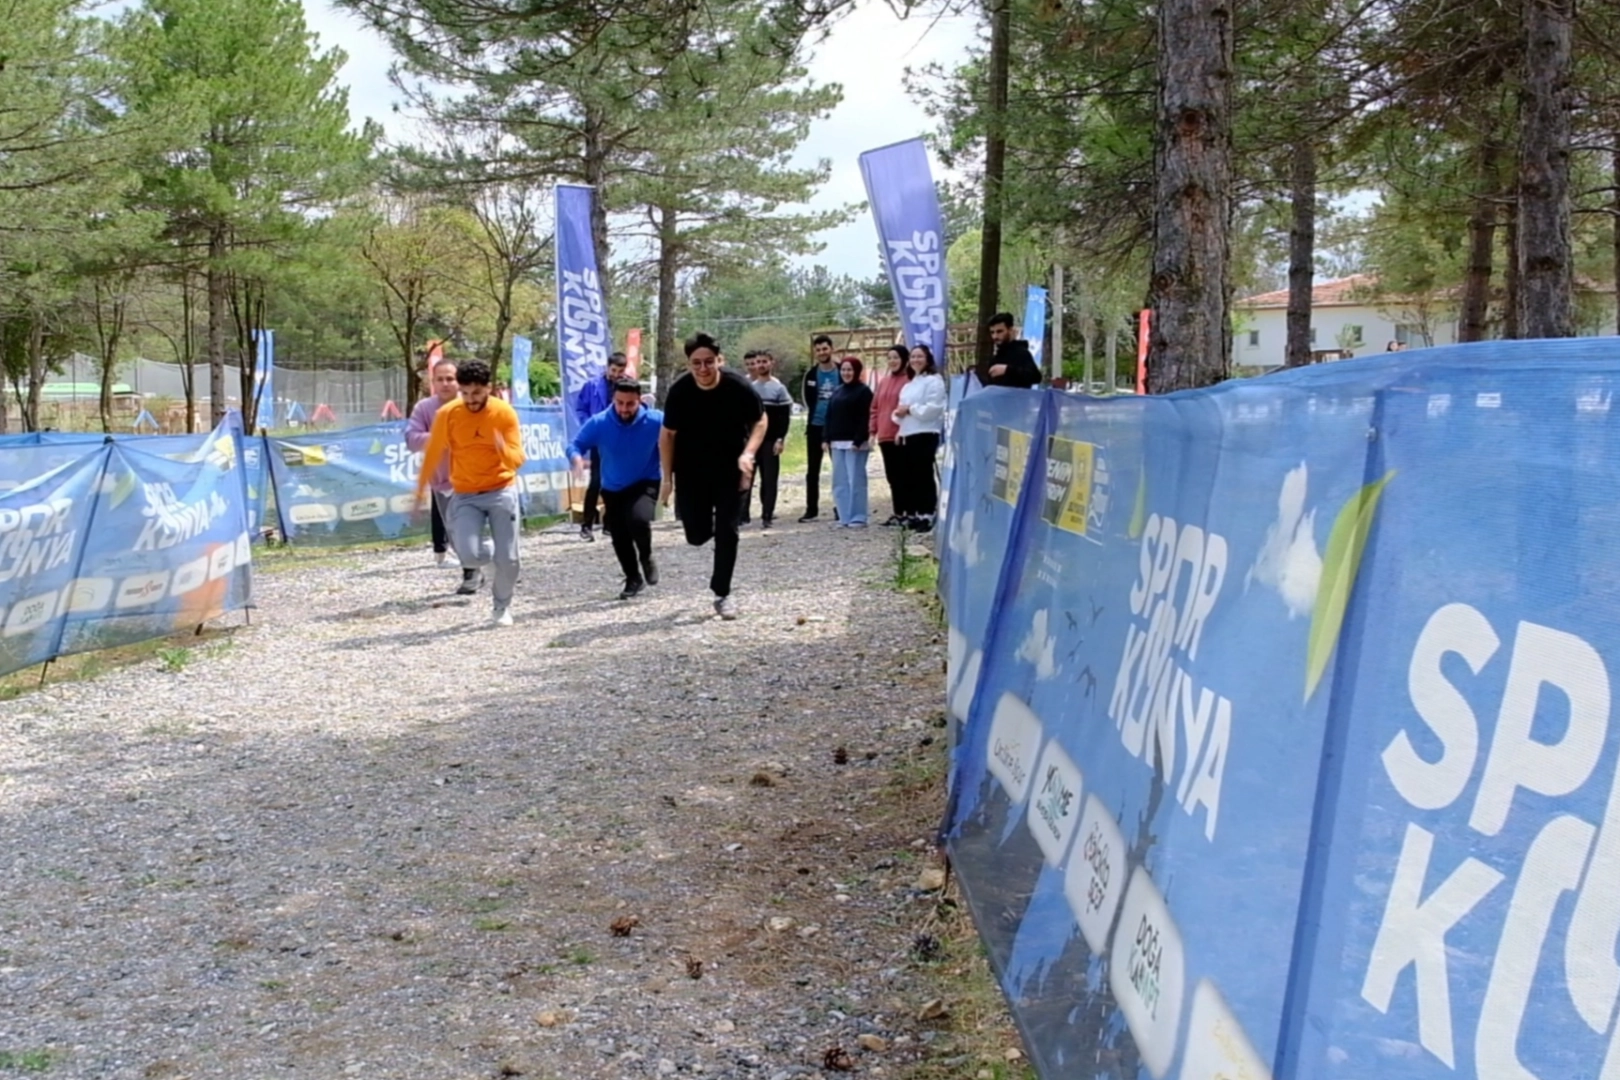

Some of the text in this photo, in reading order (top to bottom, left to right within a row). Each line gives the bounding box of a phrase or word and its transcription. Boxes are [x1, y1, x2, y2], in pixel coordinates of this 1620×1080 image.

[563, 270, 589, 394] KONYA
[582, 267, 608, 376] SPOR
[887, 240, 933, 348] KONY
[519, 424, 551, 441] POR
[1130, 512, 1228, 662] SPOR
[1107, 600, 1232, 843] KONYA
[1136, 913, 1163, 980] DOĞA
